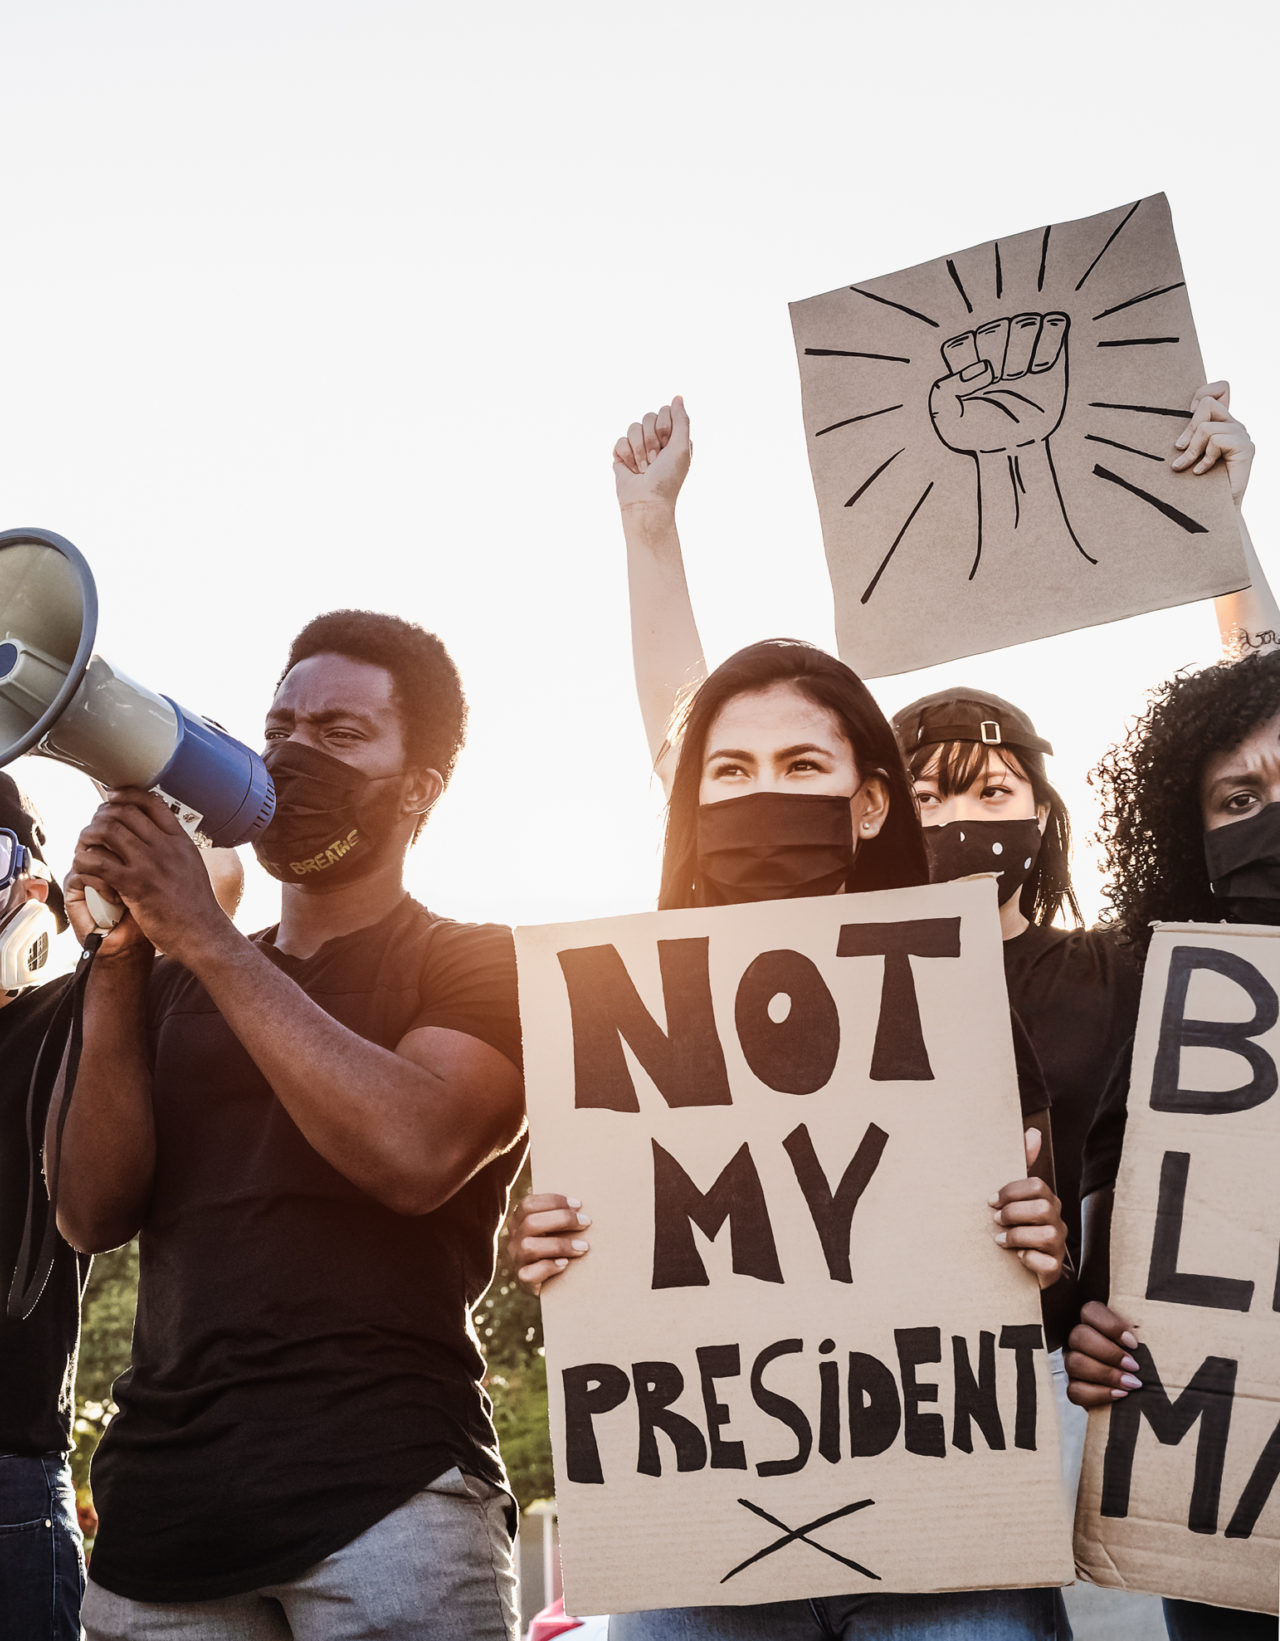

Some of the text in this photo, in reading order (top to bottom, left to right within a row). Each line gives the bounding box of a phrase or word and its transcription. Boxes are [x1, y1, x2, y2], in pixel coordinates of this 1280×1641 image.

[556, 916, 962, 1113] NOT
[651, 1122, 890, 1290] MY
[1145, 1150, 1280, 1313] L
